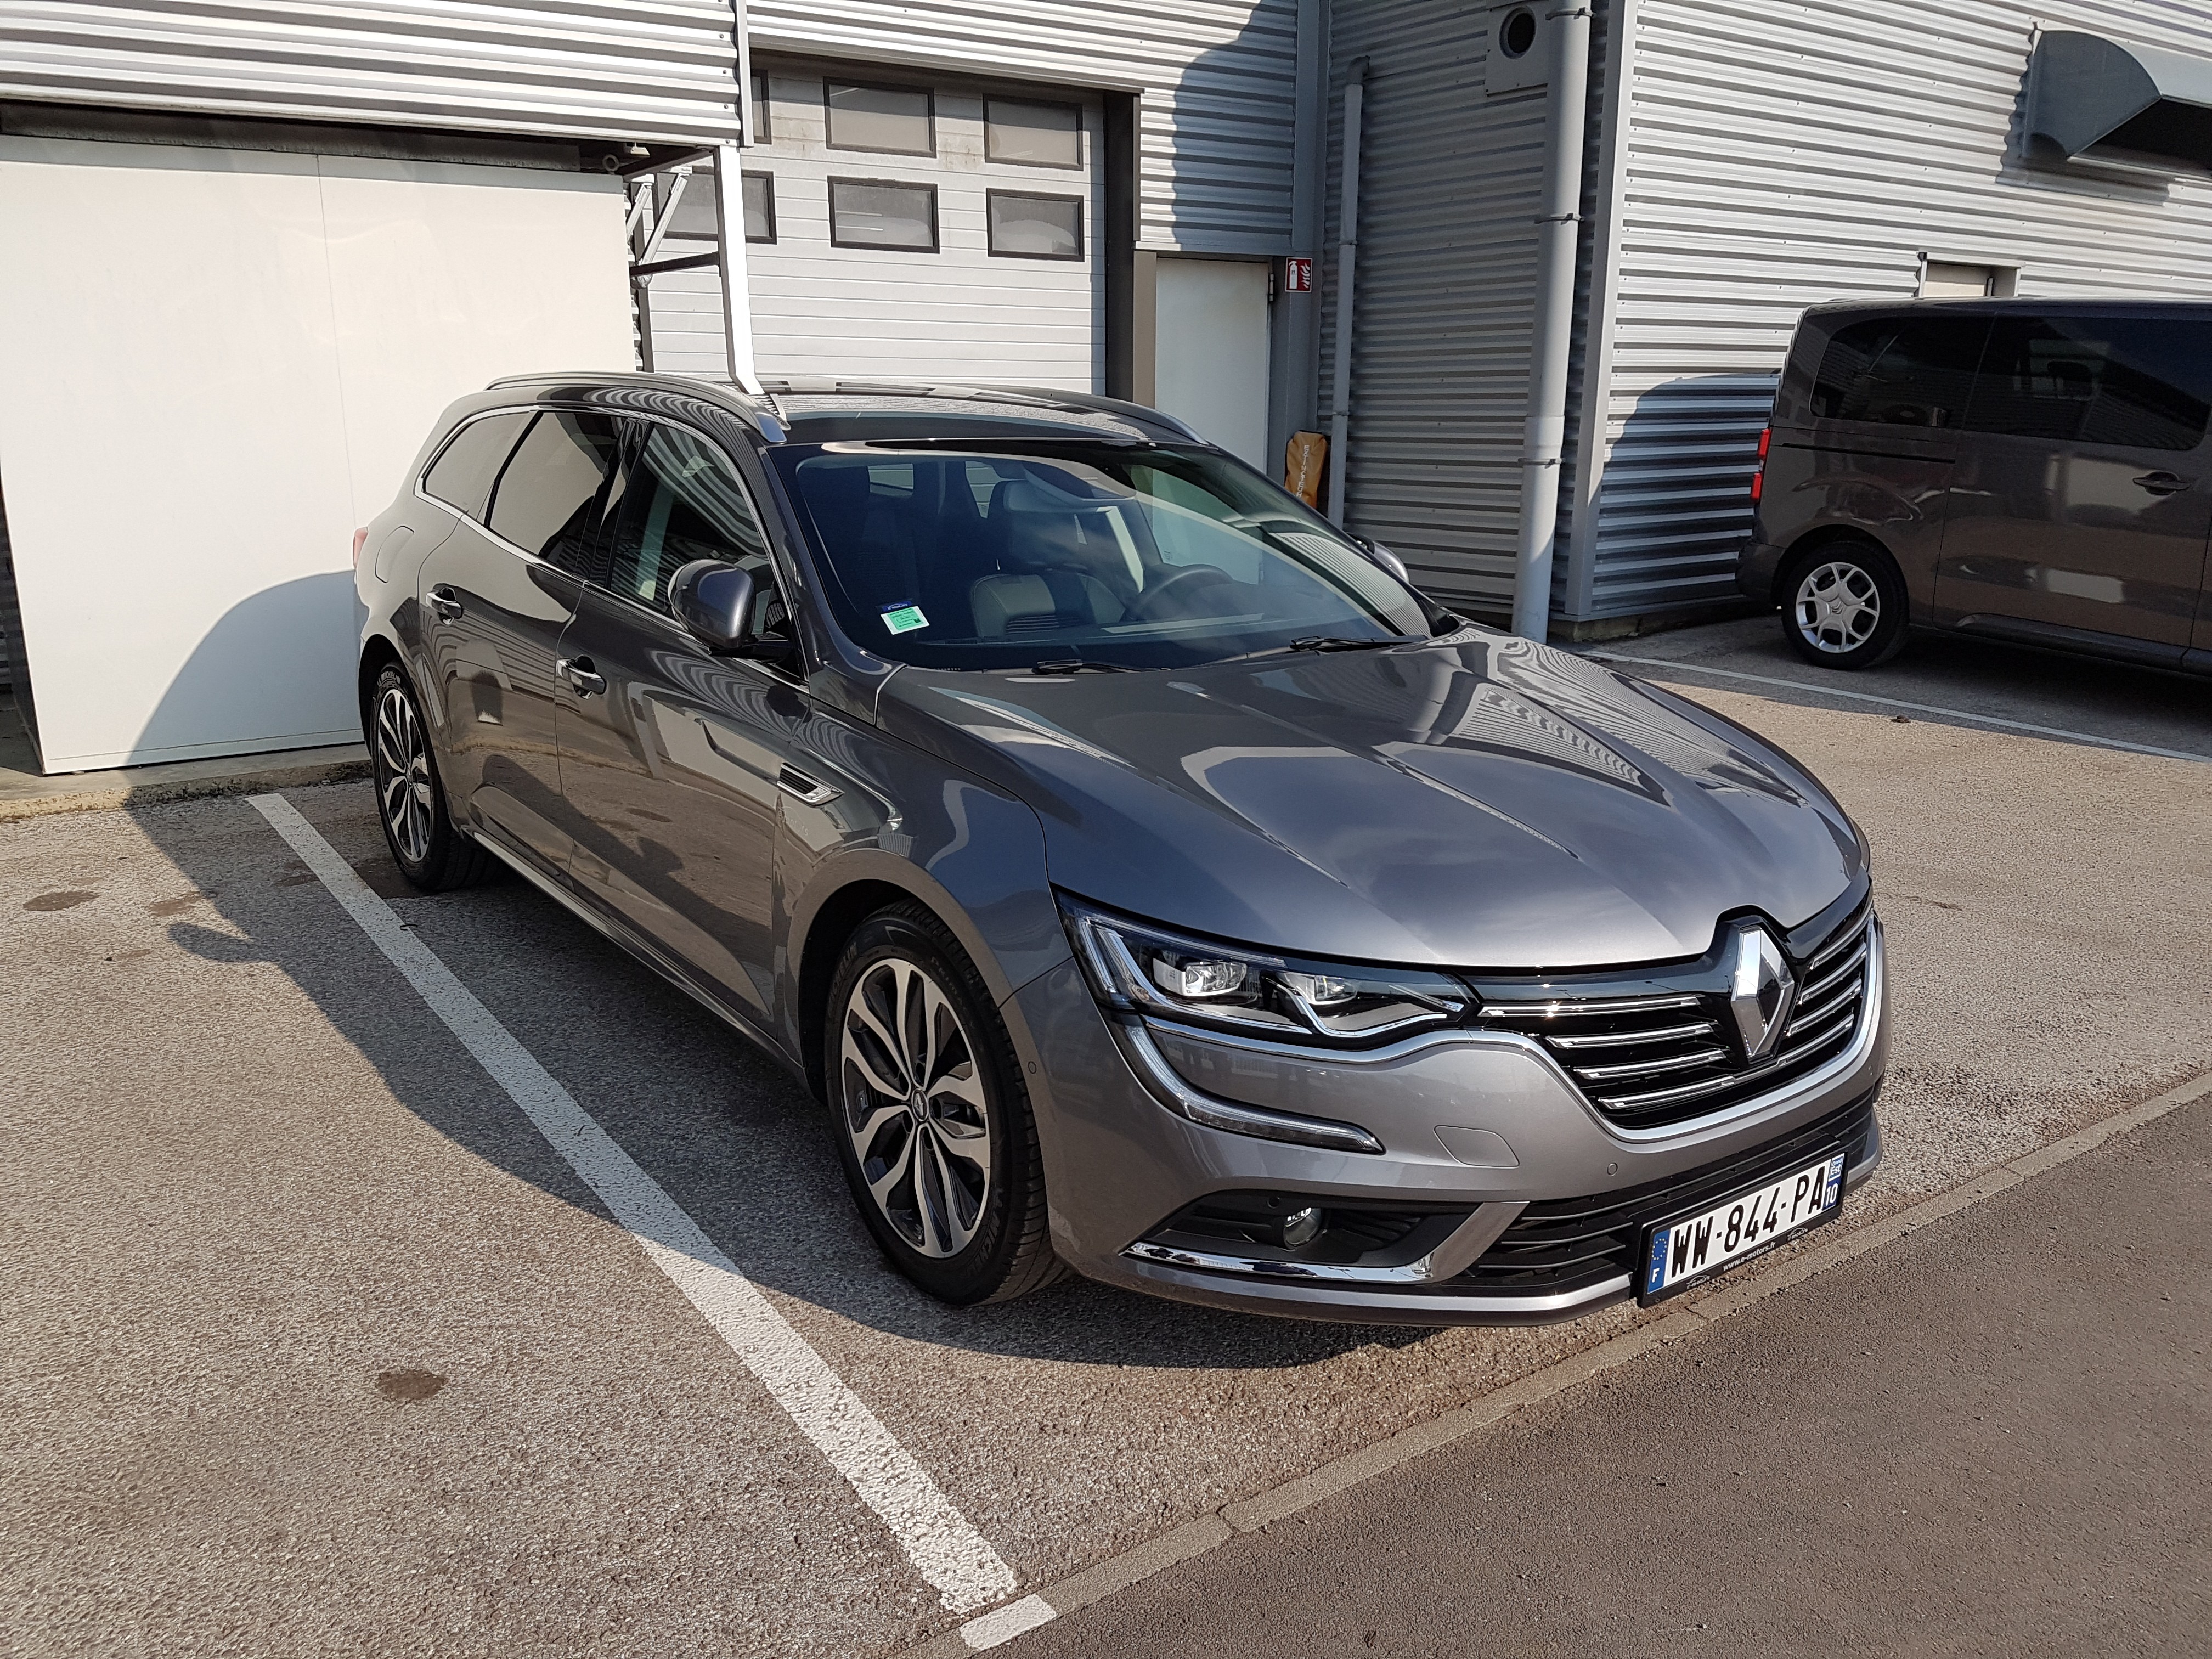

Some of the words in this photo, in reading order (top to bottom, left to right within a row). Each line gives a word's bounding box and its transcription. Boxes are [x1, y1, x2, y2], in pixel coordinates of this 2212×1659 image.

[1830, 1163, 1841, 1176] Est
[1825, 1183, 1838, 1206] 10
[1671, 1165, 1826, 1278] WW-844-PA
[1723, 1241, 1776, 1272] www.e-motors.fr
[1652, 1268, 1660, 1283] F
